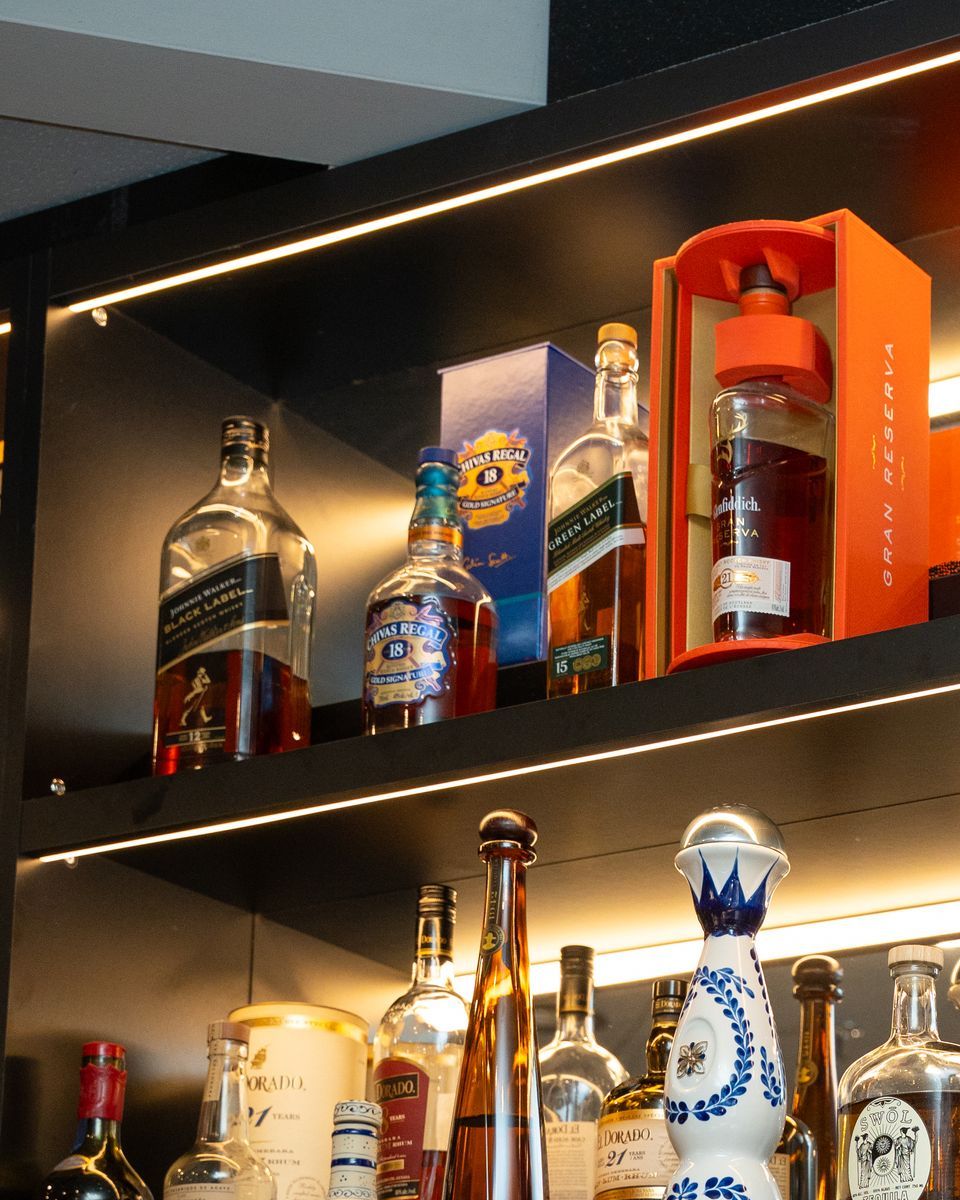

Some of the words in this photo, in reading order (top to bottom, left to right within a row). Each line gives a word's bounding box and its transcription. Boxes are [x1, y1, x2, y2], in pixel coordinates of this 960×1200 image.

[883, 343, 895, 486] RESERVA
[459, 452, 491, 473] HIVAS
[492, 449, 526, 462] REGAL
[483, 468, 498, 485] 18
[549, 524, 581, 551] GREEN
[584, 501, 616, 527] LABEL
[883, 503, 895, 587] GRAN
[721, 572, 732, 585] 21
[169, 589, 202, 618] JOHNNIE
[203, 577, 236, 597] WALKER
[164, 609, 202, 634] BLACK
[205, 589, 245, 612] LABEL
[367, 628, 400, 650] CHIVAS
[400, 622, 442, 642] REGAL
[389, 643, 405, 658] 18
[556, 660, 568, 674] 15
[189, 730, 200, 742] 12
[248, 1075, 304, 1093] ORADO
[604, 1128, 651, 1146] DORADO
[606, 1148, 627, 1167] 21
